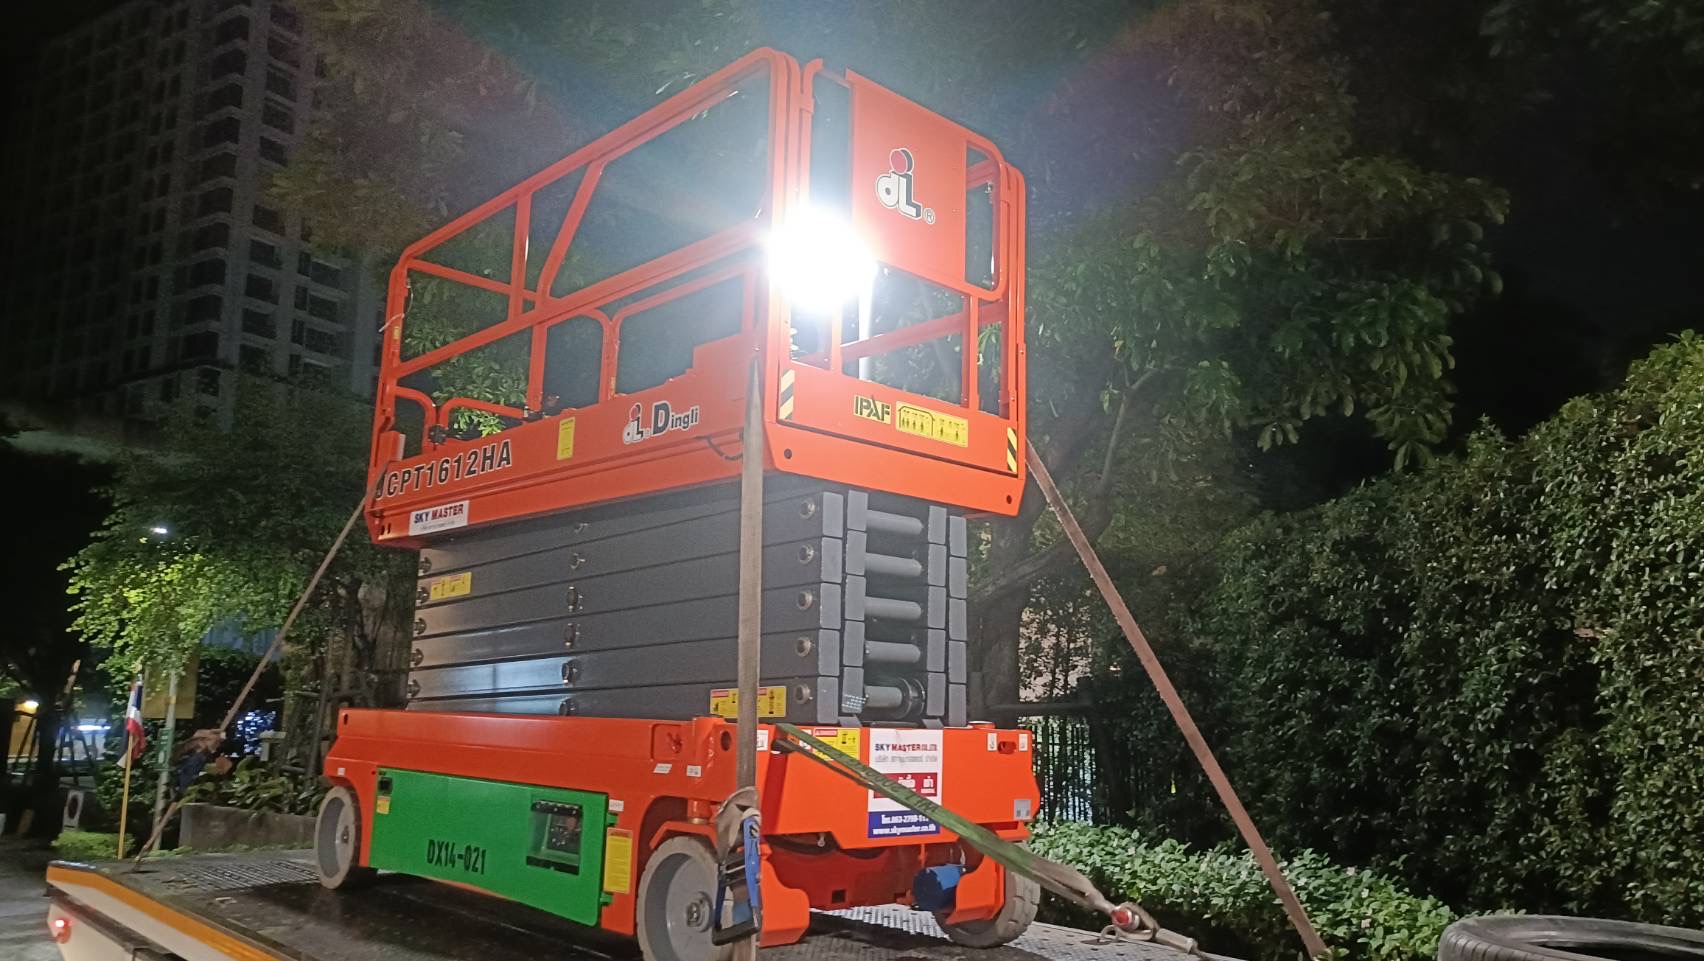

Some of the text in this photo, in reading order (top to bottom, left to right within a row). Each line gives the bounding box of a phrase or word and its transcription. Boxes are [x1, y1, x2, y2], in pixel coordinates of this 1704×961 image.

[652, 401, 699, 435] Dingli
[855, 395, 890, 421] IPAF
[375, 439, 512, 500] JCPT1612HA
[414, 504, 464, 524] SKY MASTER
[875, 743, 890, 752] SKY
[891, 743, 920, 752] MASTER
[426, 839, 487, 875] DX14-021
